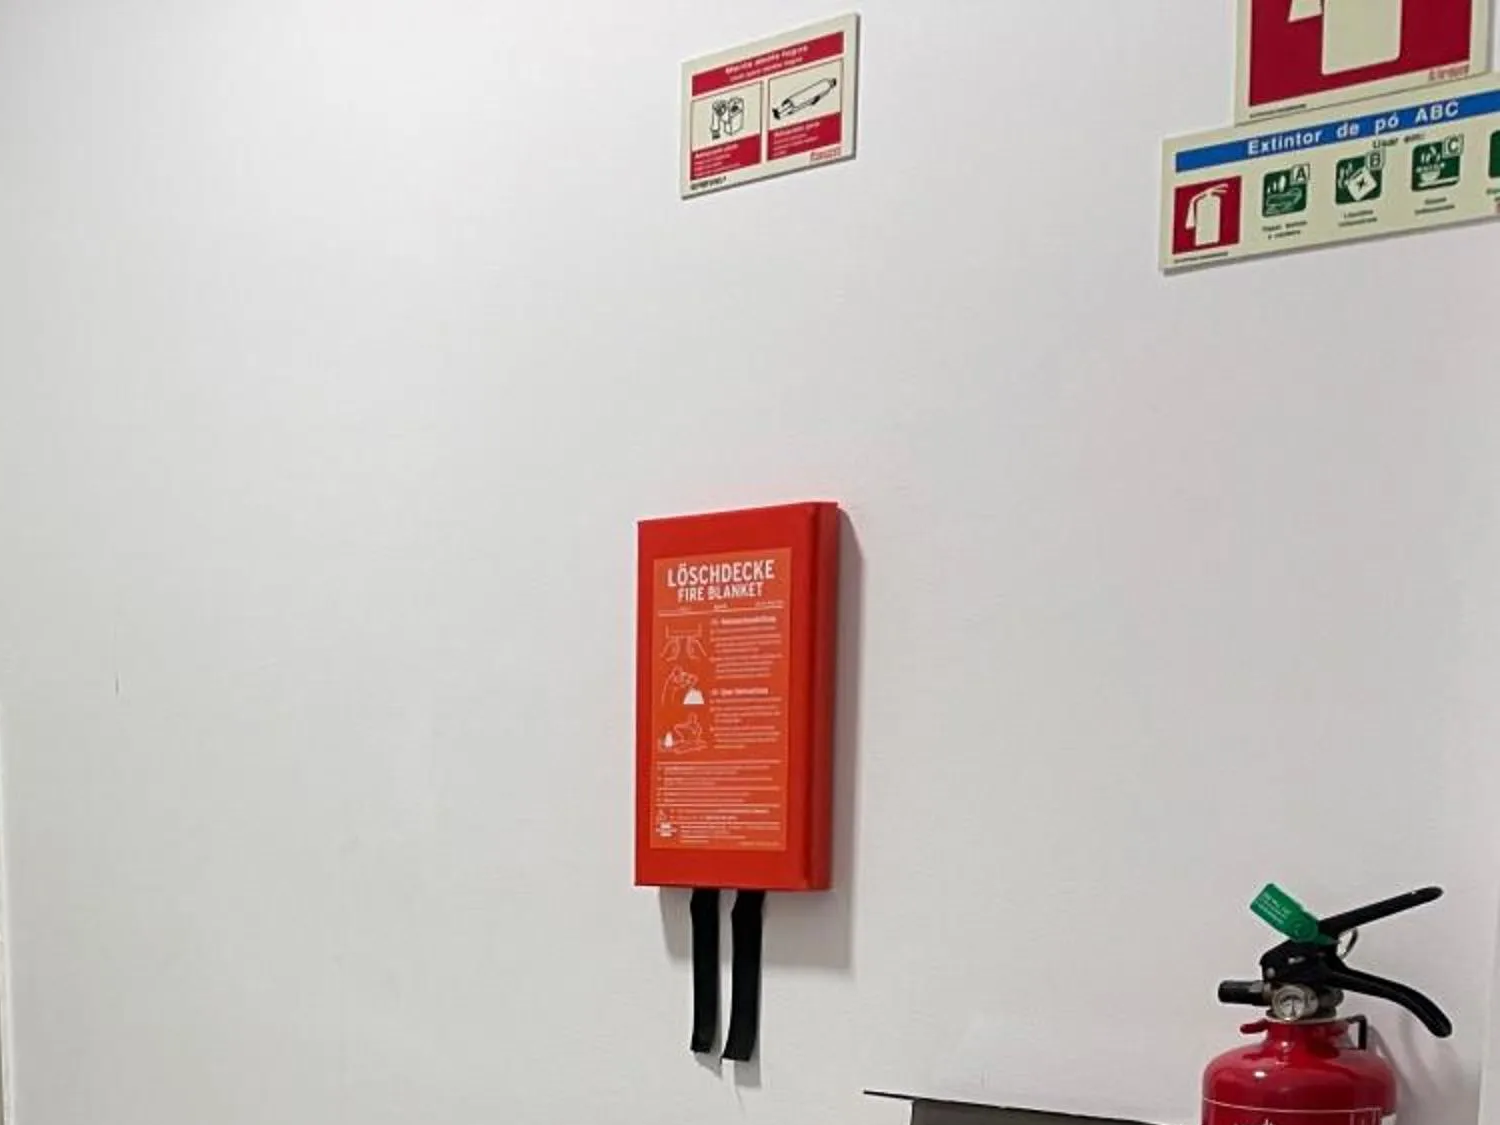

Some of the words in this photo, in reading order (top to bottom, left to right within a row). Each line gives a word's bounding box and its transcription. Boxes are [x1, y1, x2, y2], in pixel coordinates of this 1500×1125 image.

[1248, 130, 1322, 155] Extintor
[1336, 121, 1359, 138] de
[1374, 112, 1399, 134] pó
[1415, 101, 1459, 125] ABC
[1448, 136, 1460, 153] C
[1370, 152, 1381, 167] B
[1296, 166, 1307, 180] A
[667, 559, 775, 587] LÖSCHDECKE
[677, 586, 704, 602] FIRE
[707, 582, 765, 600] BLANKET
